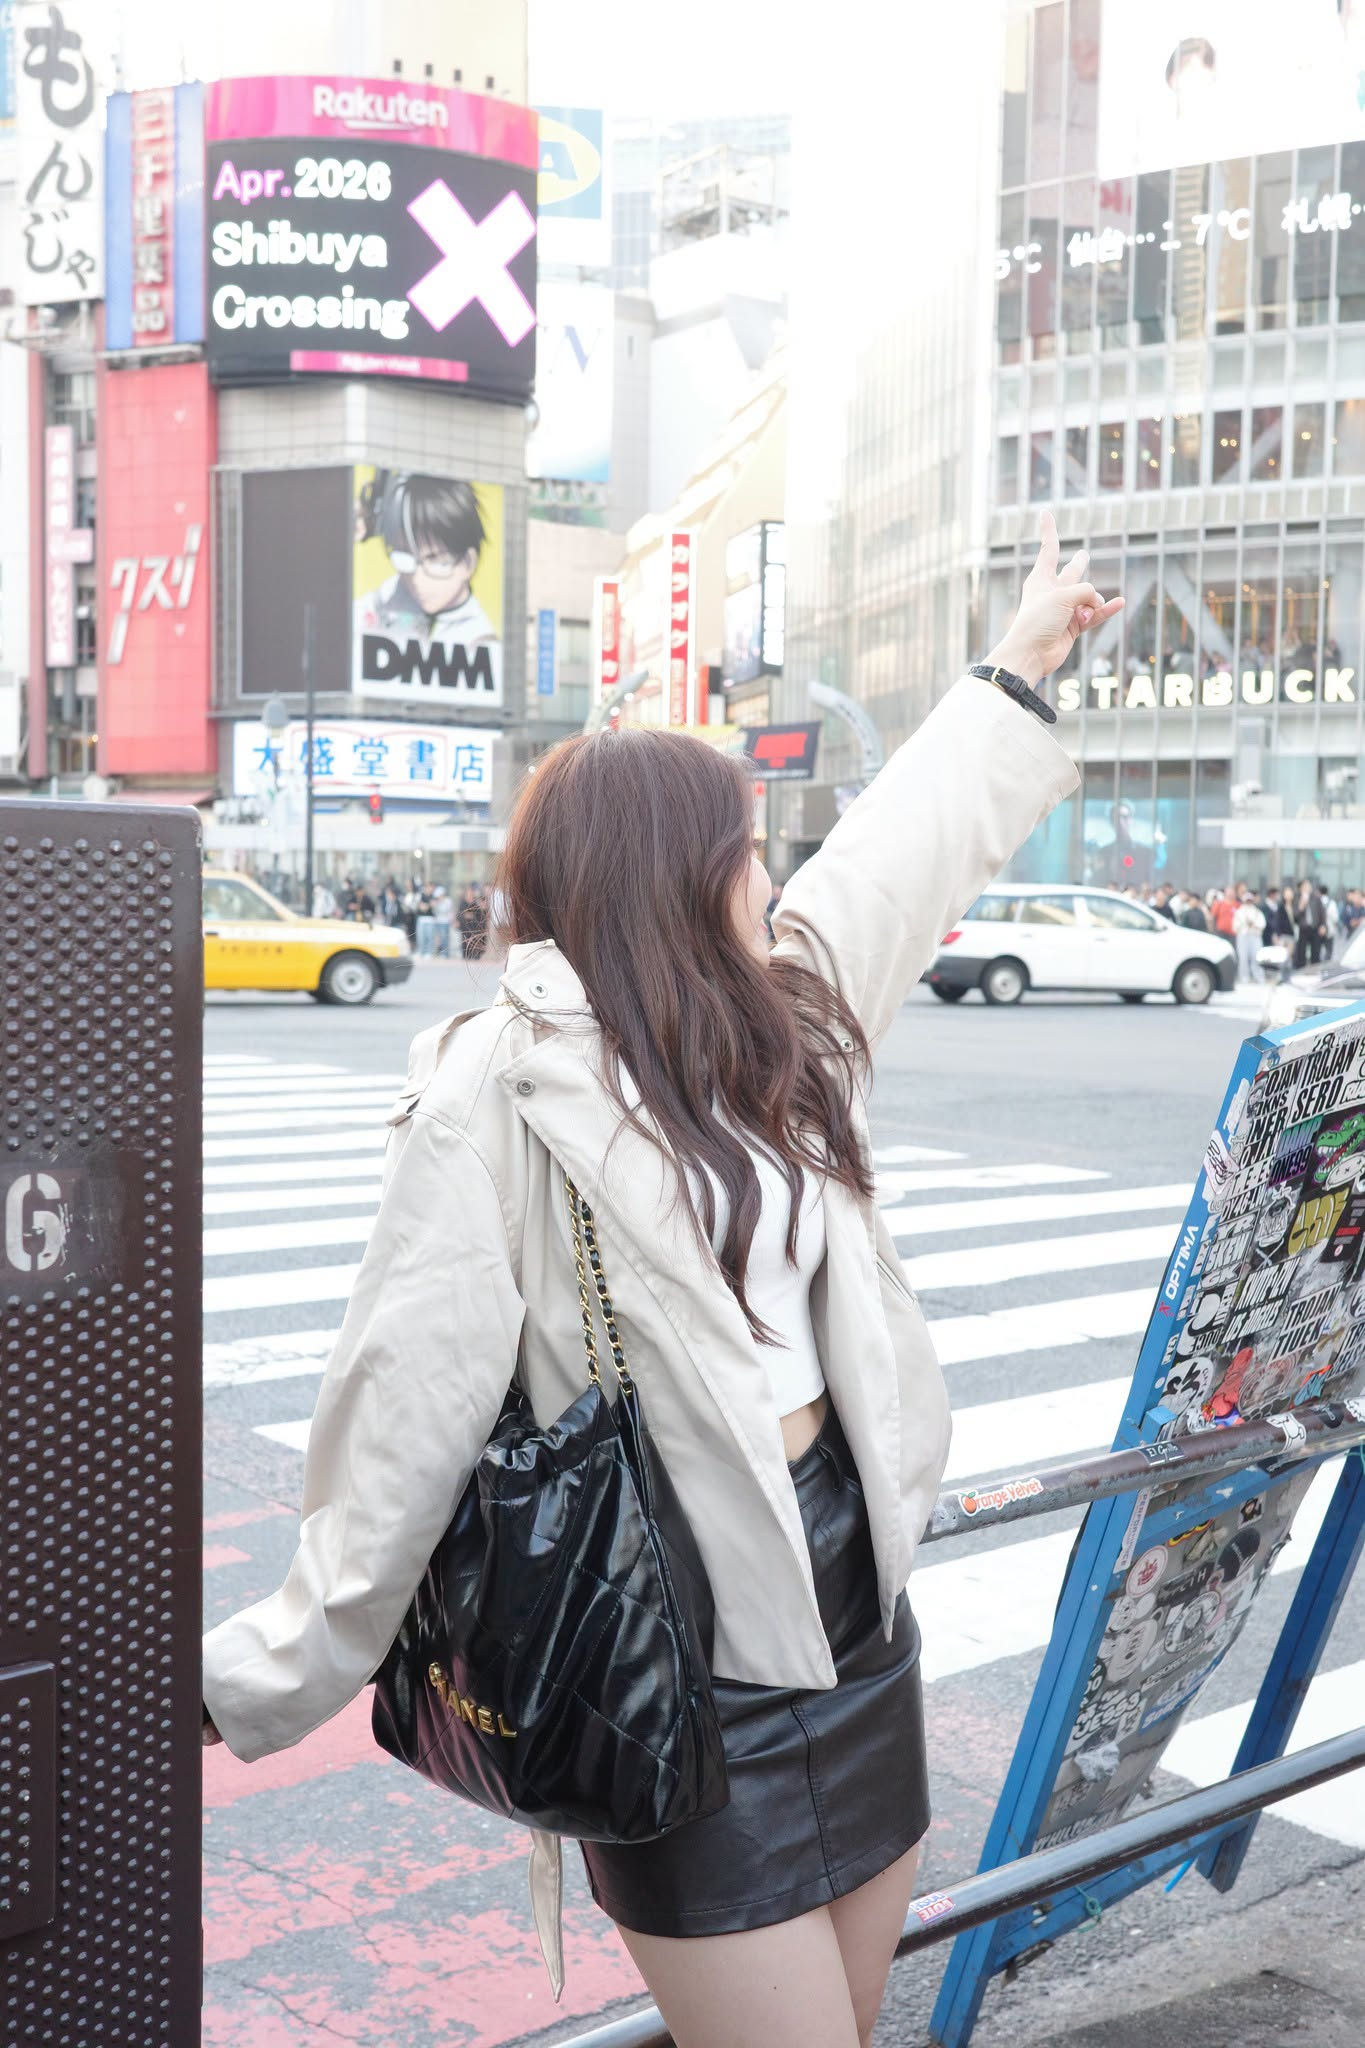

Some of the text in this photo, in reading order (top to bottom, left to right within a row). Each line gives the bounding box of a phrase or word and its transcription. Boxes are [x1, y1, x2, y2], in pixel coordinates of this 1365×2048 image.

[313, 84, 449, 130] Rakuten
[22, 6, 97, 291] もんじゃ
[212, 220, 389, 272] Shibuya
[212, 284, 411, 340] Crossing
[106, 523, 203, 665] クスリ
[362, 634, 495, 691] DMM
[1058, 668, 1356, 711] STARBUCK
[253, 737, 485, 783] 大盛堂書店
[1301, 1039, 1361, 1088] TROJAN
[1291, 1075, 1344, 1123] SERO
[1165, 1225, 1200, 1300] OPTIMA
[1285, 1286, 1341, 1330] TROJAN
[1010, 1480, 1043, 1501] Velvet
